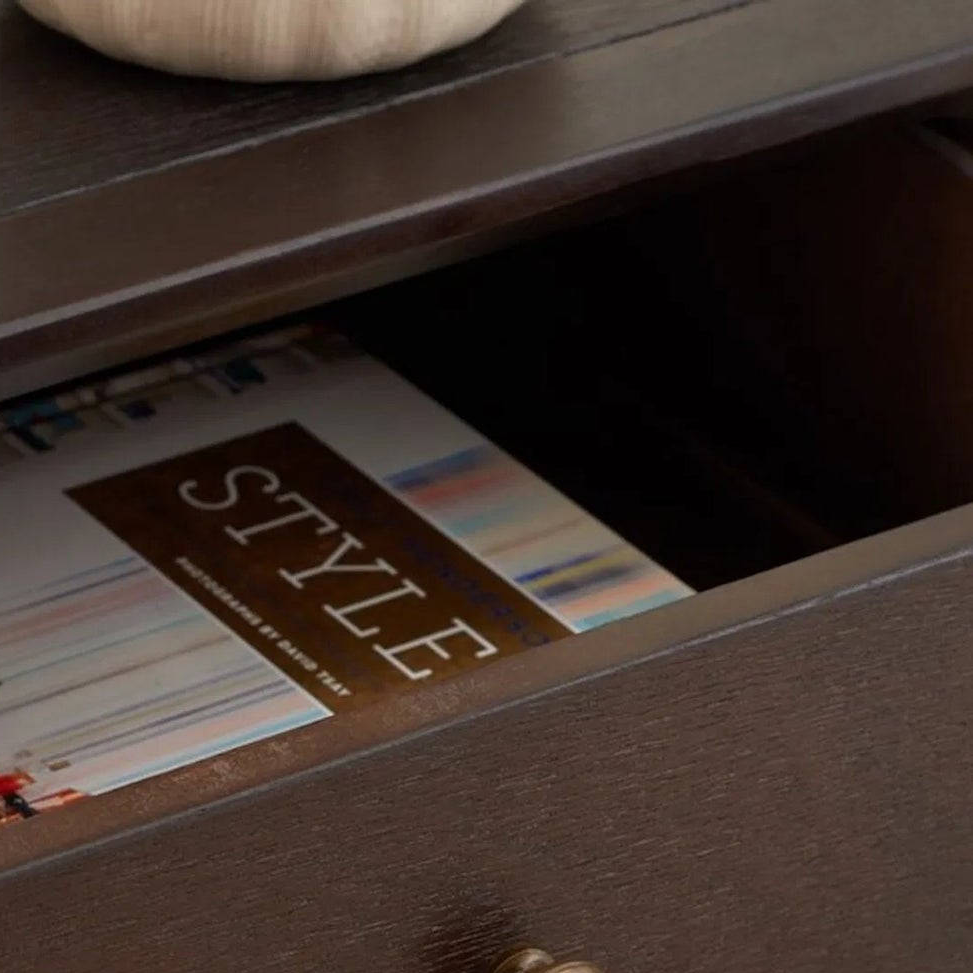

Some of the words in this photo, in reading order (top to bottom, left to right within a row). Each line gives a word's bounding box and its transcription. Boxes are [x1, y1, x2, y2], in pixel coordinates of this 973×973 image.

[174, 556, 262, 627] PHOTOGRAPHS
[258, 624, 283, 640] BY
[276, 640, 319, 671] DAVID
[178, 464, 500, 681] STYLE
